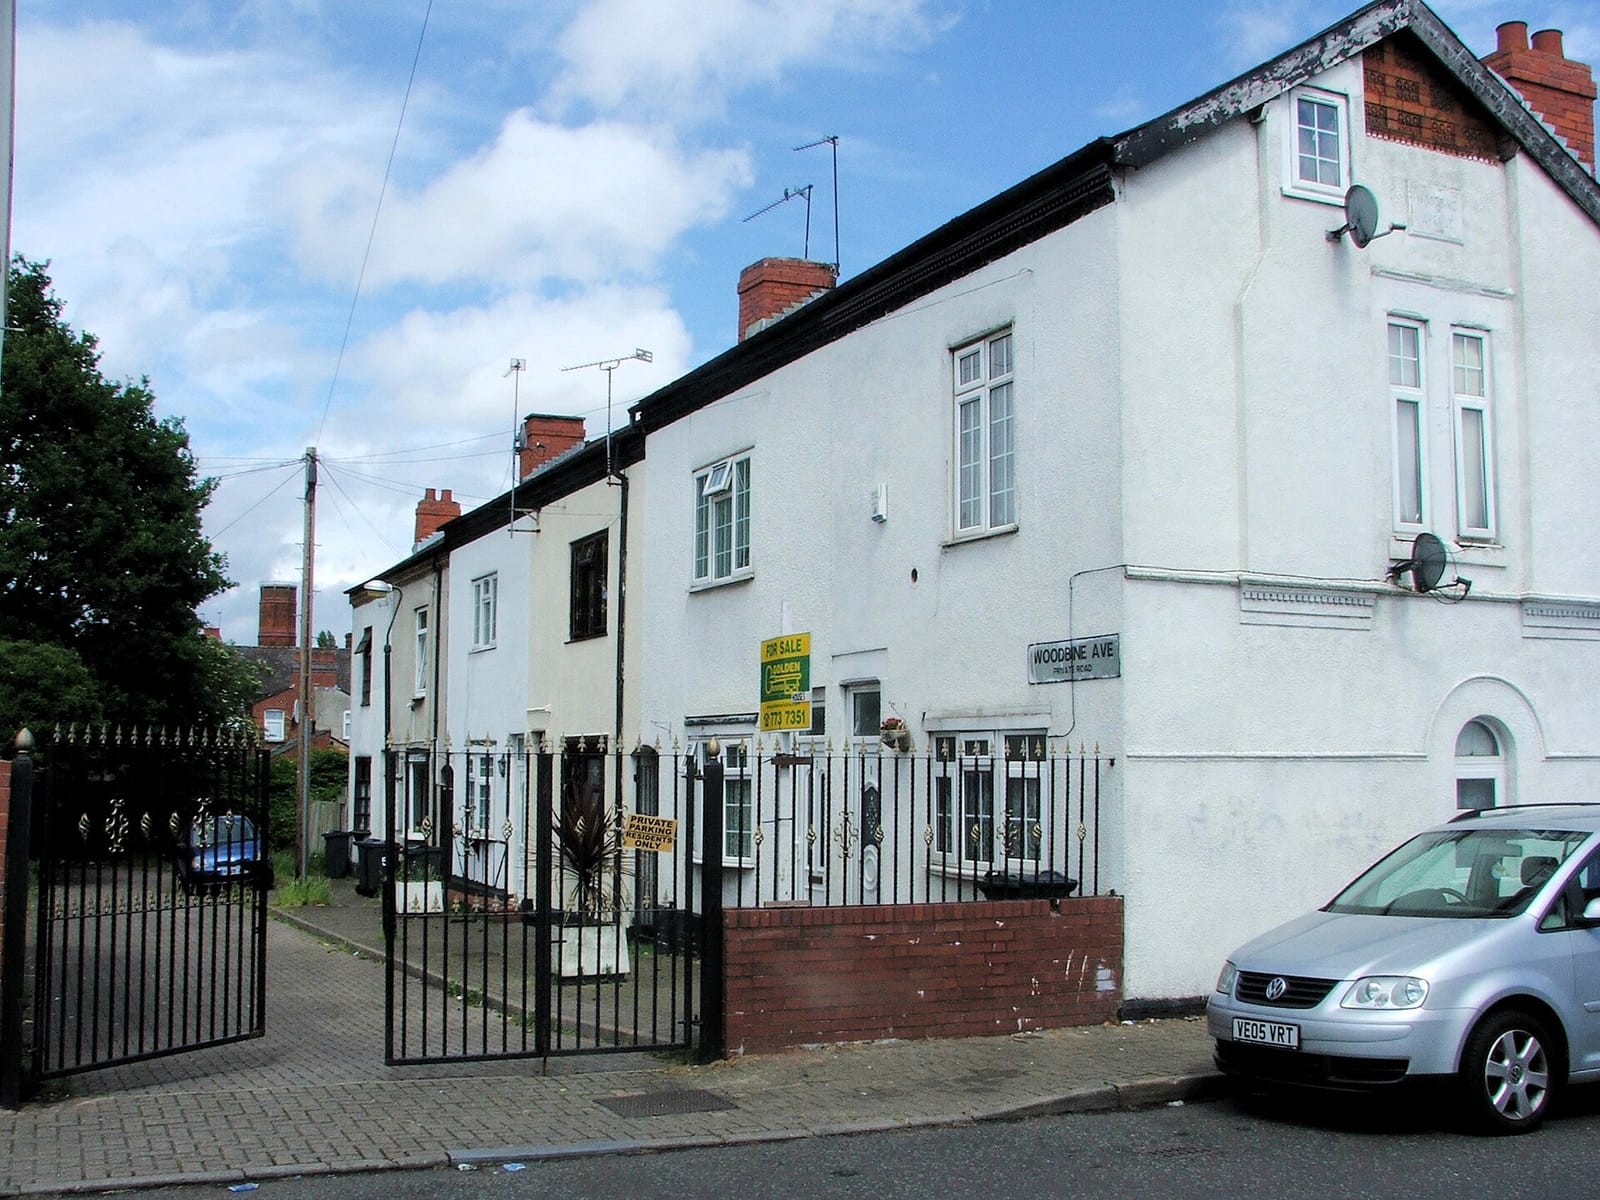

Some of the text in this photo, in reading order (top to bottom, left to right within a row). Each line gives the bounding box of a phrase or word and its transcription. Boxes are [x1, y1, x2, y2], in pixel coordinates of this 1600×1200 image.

[766, 639, 802, 657] FOR SALE
[1092, 642, 1114, 659] AVE
[773, 661, 801, 674] GOLDEN
[1076, 664, 1093, 673] ROAD
[785, 709, 805, 725] 7351
[630, 815, 673, 828] PRIVATE
[629, 823, 672, 835] PARKING
[626, 831, 673, 843] RESIDENTS
[635, 839, 661, 849] ONLY
[1269, 1024, 1294, 1044] VRT
